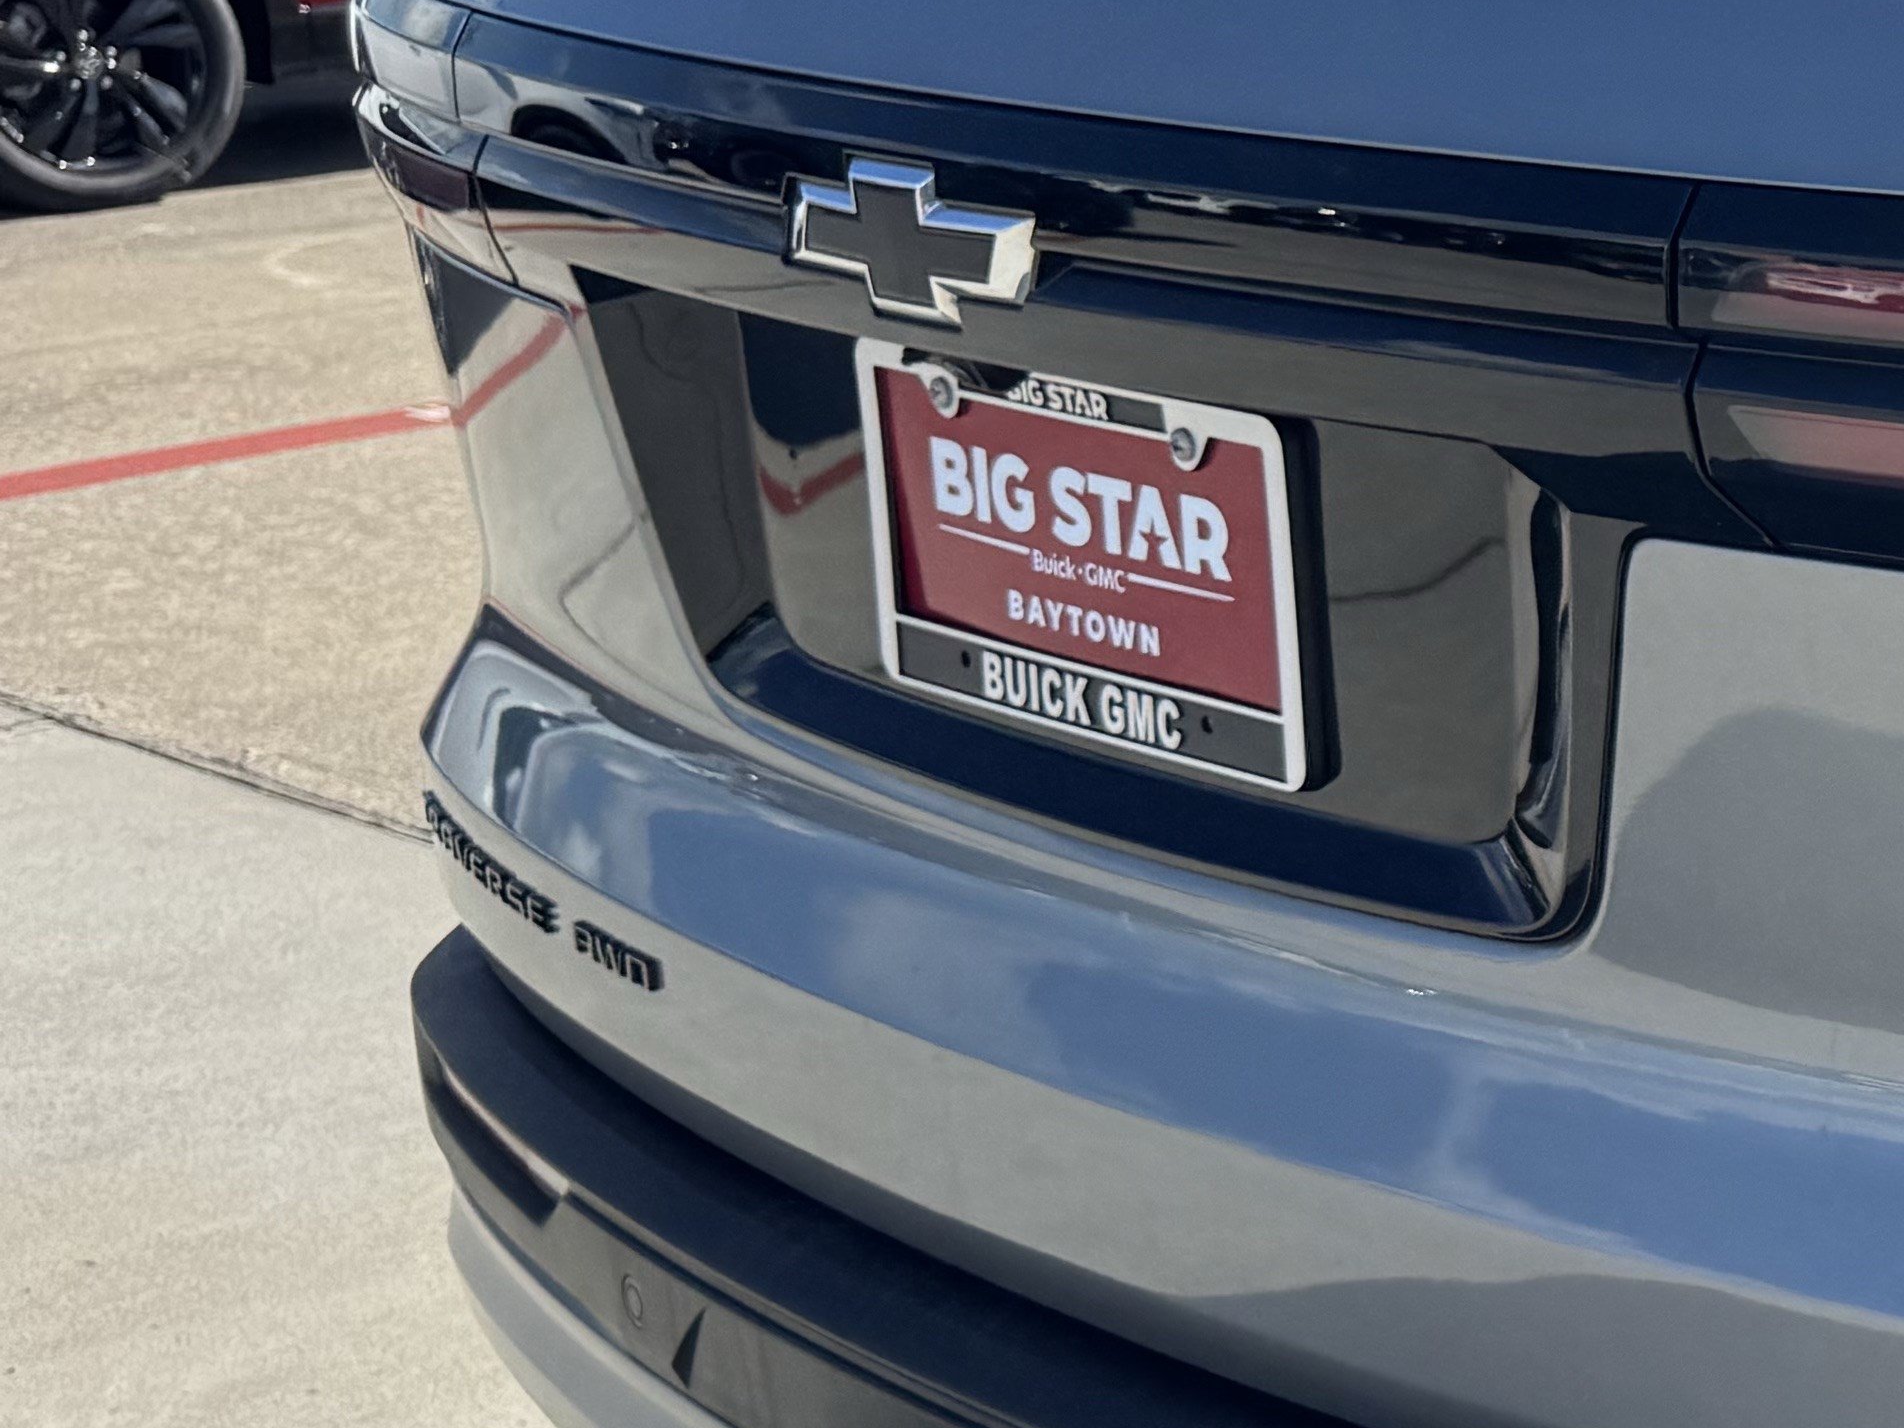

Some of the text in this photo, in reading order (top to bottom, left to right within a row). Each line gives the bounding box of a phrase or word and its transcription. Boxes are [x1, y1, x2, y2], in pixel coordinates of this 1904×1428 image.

[1045, 383, 1108, 420] STAR
[929, 436, 1231, 581] BIG STAR
[1007, 588, 1160, 657] BAYTOWN
[981, 650, 1183, 751] BUICK GMC
